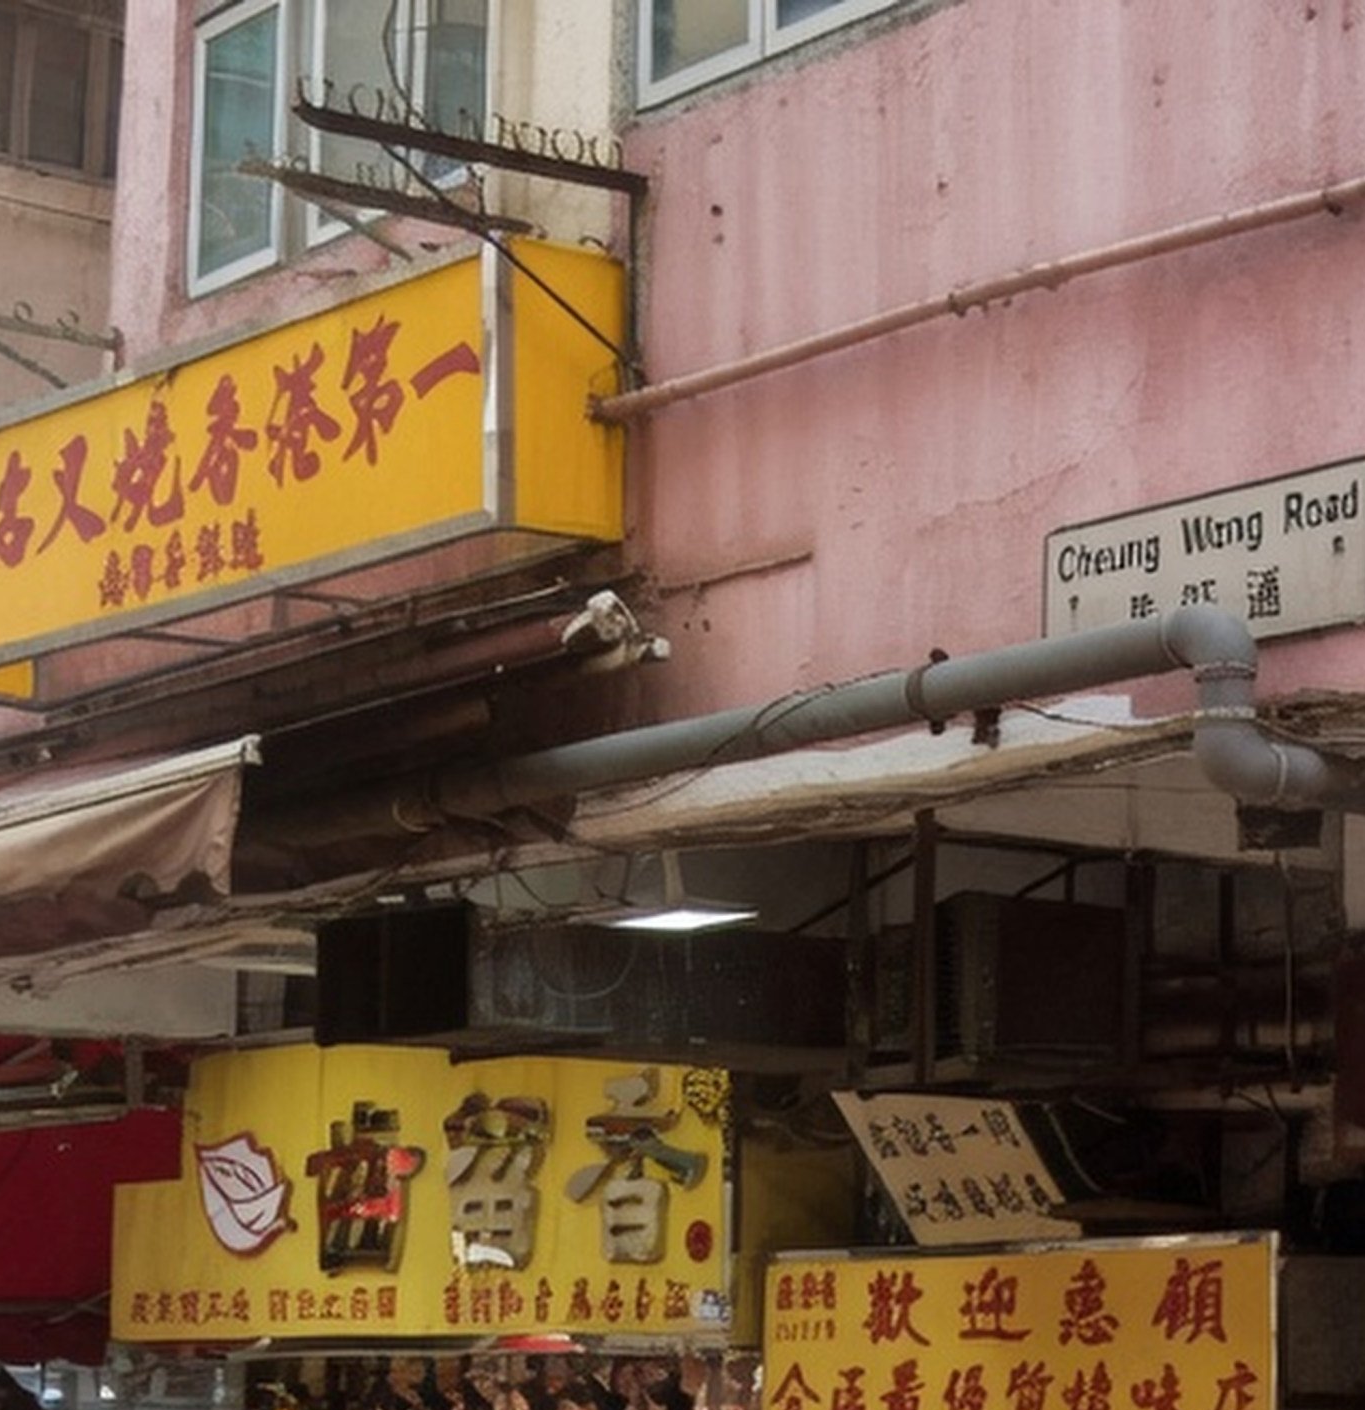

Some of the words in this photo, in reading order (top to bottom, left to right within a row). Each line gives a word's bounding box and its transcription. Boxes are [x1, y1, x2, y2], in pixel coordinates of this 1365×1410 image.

[1058, 535, 1160, 582] Cheung
[1283, 481, 1359, 534] Road
[863, 1257, 1228, 1347] 歡迎惠顧
